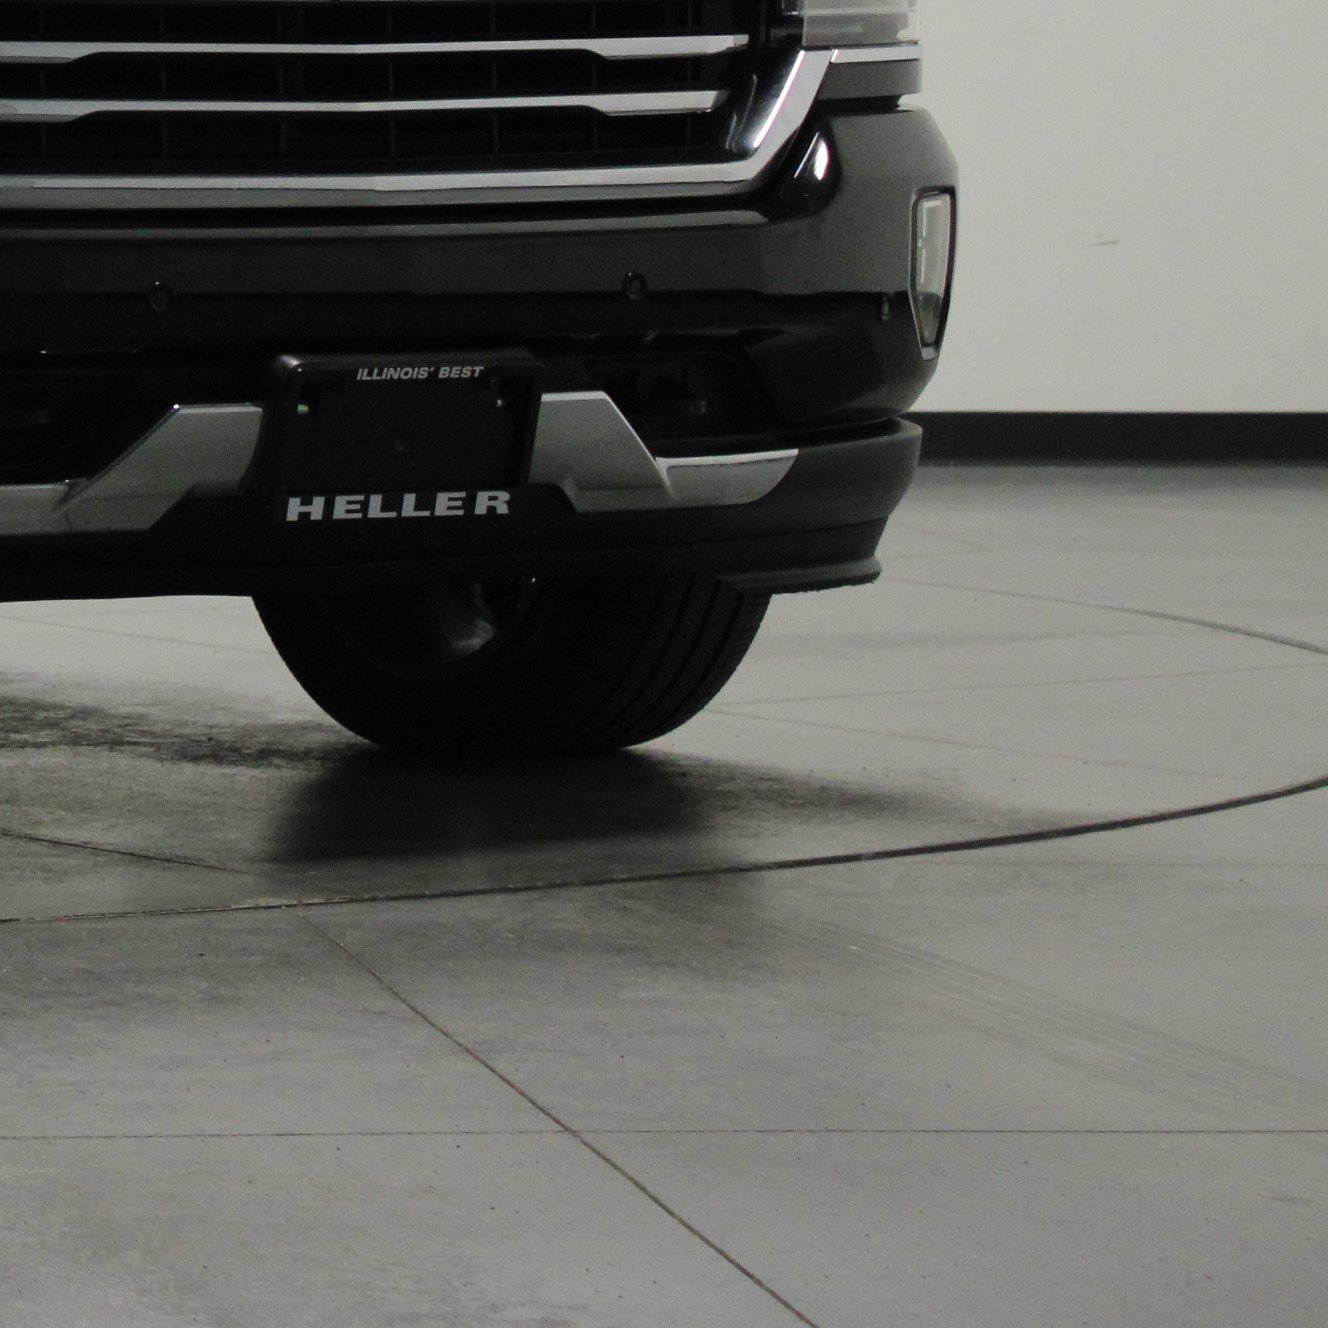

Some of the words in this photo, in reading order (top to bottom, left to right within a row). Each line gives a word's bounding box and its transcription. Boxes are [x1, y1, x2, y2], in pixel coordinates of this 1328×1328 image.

[356, 366, 435, 381] ILLINOIS'
[438, 365, 485, 379] BEST
[285, 490, 511, 522] HELLER
